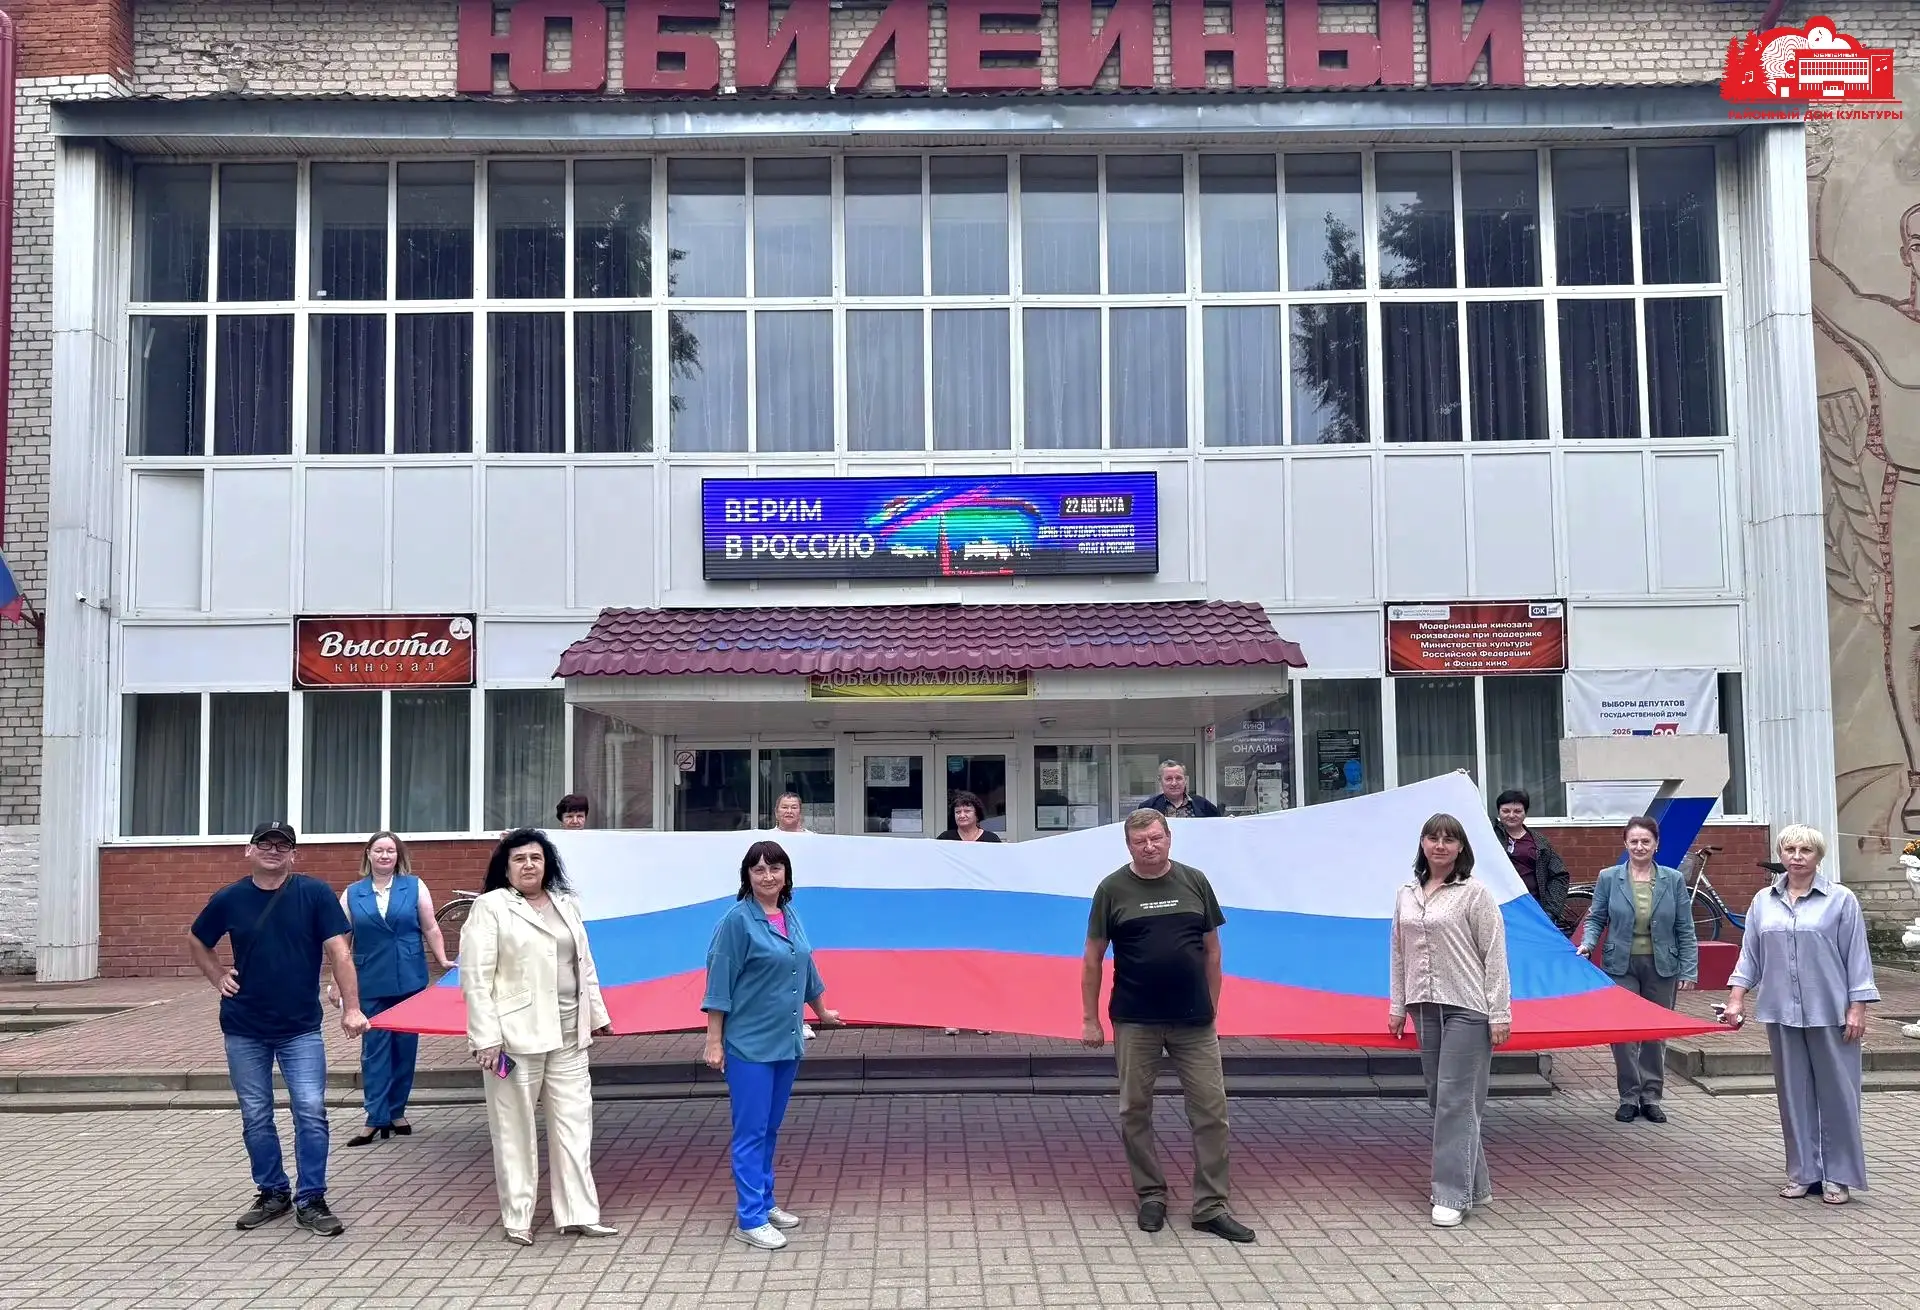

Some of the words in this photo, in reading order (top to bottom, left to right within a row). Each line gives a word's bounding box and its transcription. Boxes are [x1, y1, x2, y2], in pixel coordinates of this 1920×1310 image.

[1065, 497, 1079, 513] 22
[1080, 496, 1125, 513] АВГУСТА
[725, 499, 822, 522] ВЕРИМ
[725, 535, 743, 560] В
[751, 533, 876, 560] РОССИЮ
[1419, 622, 1488, 631] Модернизация
[1490, 621, 1533, 629] кинозала
[1410, 632, 1470, 641] произведена
[1473, 632, 1490, 640] при
[1492, 631, 1542, 639] поддержке
[318, 631, 452, 657] Высота
[1420, 641, 1487, 649] Министерства
[1490, 640, 1533, 649] культуры
[1422, 650, 1477, 659] Российской
[1480, 649, 1531, 658] Федерации
[1453, 659, 1483, 668] Фонда
[820, 671, 882, 690] ДОБРО
[886, 669, 1019, 687] ПОЖАЛОВАТЬ!
[1602, 700, 1637, 708] ВЫБОРЫ
[1638, 699, 1685, 708] ДЕПУТАТОВ
[1600, 711, 1666, 719] ГОСУДАРСТВЕННОЙ
[1233, 742, 1277, 753] ОНЛАЙН
